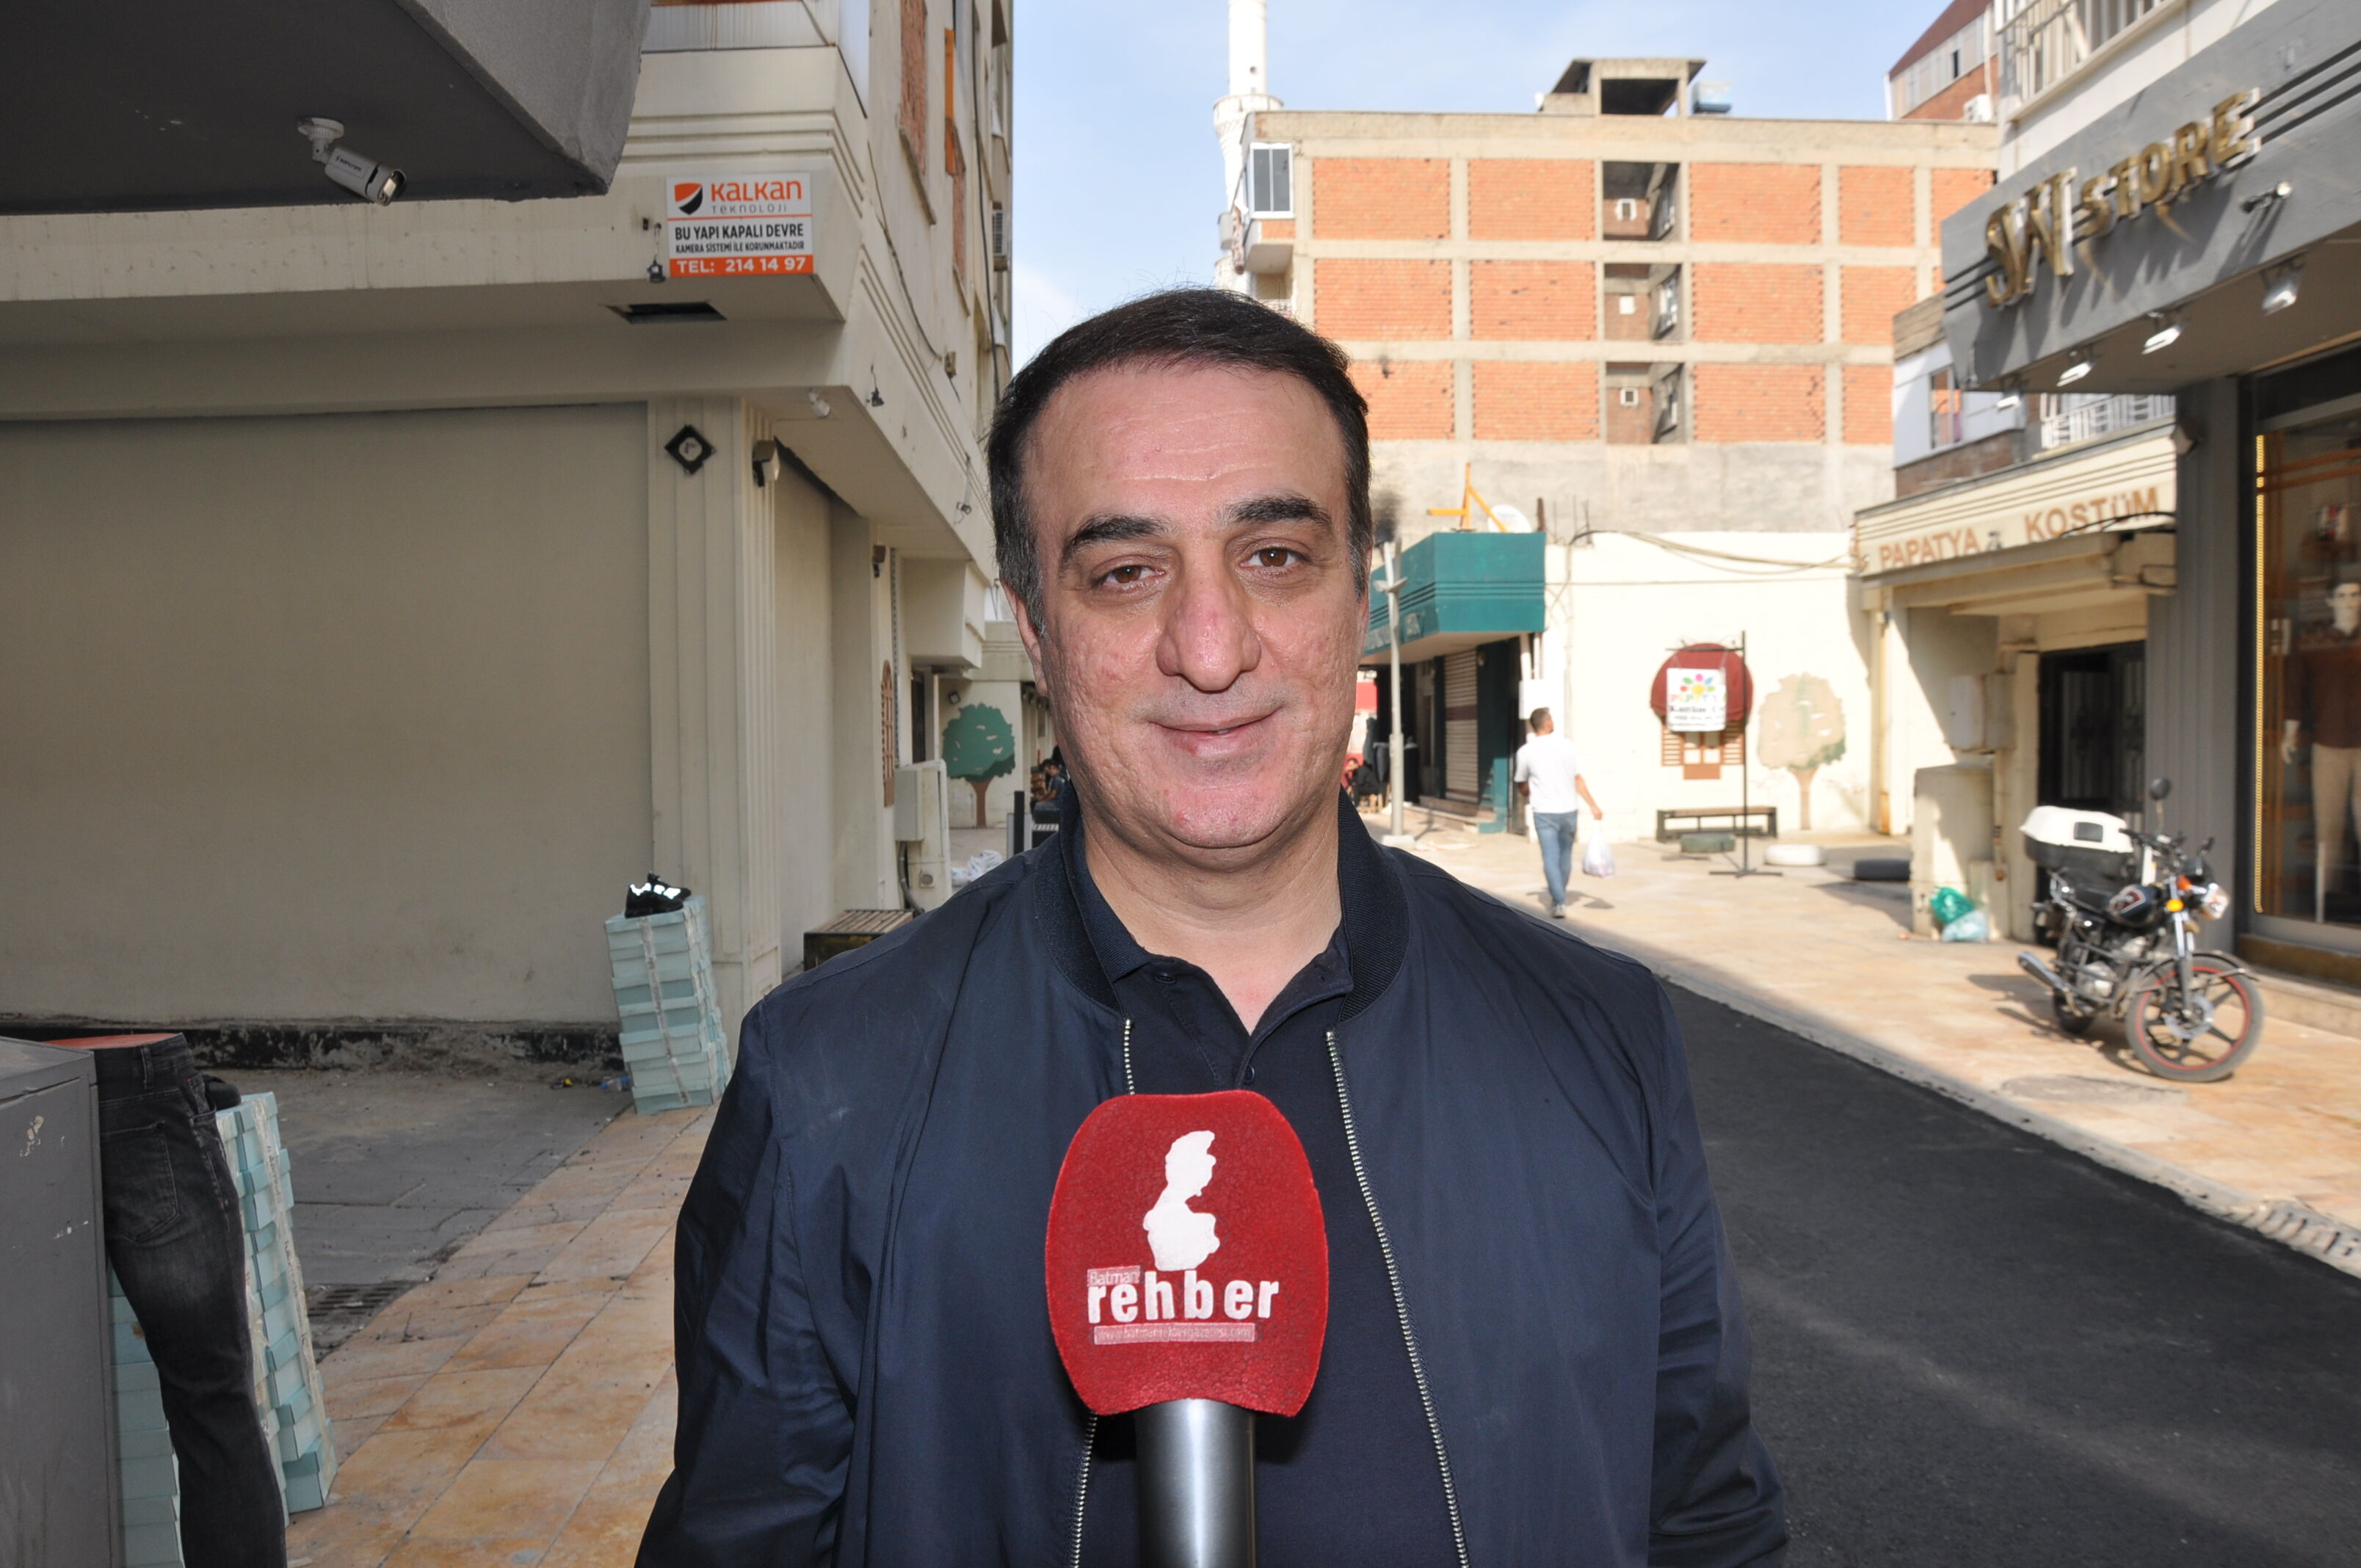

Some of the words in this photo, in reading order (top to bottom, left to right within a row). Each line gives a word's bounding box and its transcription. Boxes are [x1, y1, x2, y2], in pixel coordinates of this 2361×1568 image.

[2080, 87, 2261, 239] STORE
[675, 227, 691, 240] BU
[694, 225, 719, 239] YAPI
[722, 224, 763, 239] KAPALI
[766, 223, 804, 237] DEVRE
[675, 243, 704, 254] KAMERA
[706, 242, 732, 253] SİSTEMİ
[733, 241, 743, 252] İLE
[745, 241, 805, 252] KORUNMAKTADIR
[677, 260, 714, 273] TEL:
[725, 258, 754, 272] 214
[760, 258, 779, 272] 14
[784, 257, 806, 270] 97
[1878, 527, 1981, 570] PAPATYA
[2024, 487, 2159, 542] KOSTÜM
[1089, 1271, 1139, 1285] Batman
[1087, 1270, 1280, 1324] rehber
